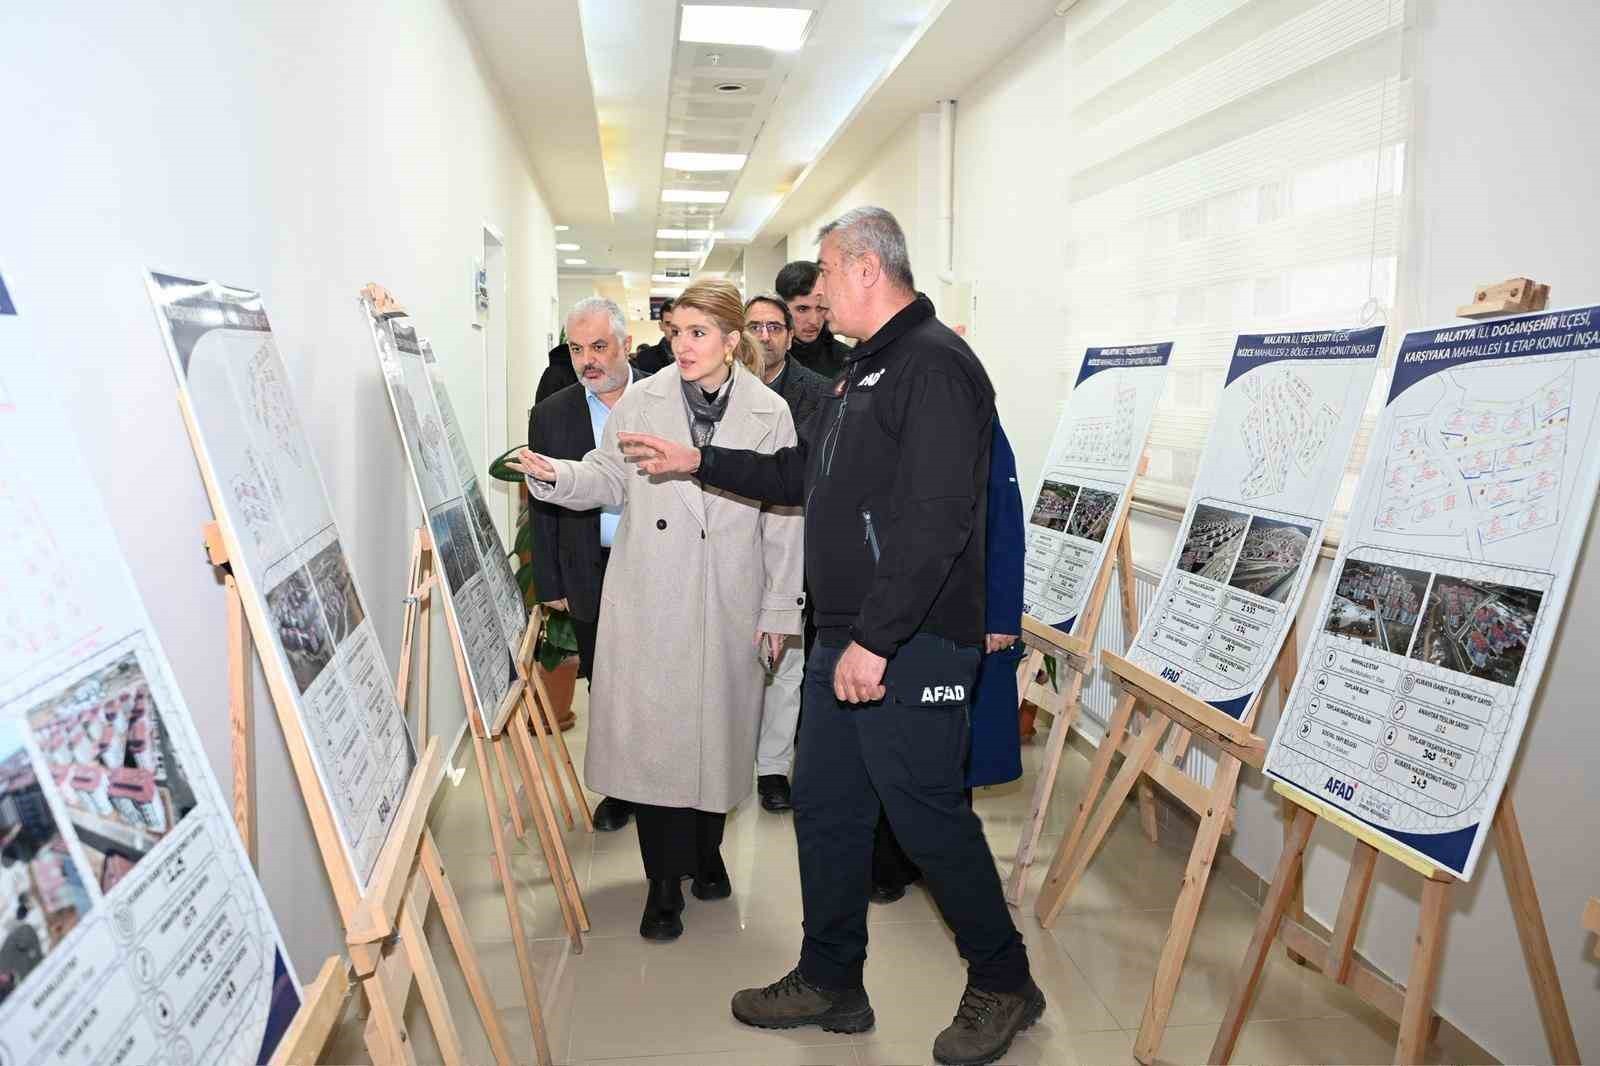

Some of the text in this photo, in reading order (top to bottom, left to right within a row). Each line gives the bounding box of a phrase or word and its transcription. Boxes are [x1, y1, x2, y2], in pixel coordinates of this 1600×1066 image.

[1434, 327, 1476, 344] MALATYA
[1491, 315, 1558, 337] DOĞANŞEHİR
[1558, 309, 1591, 330] İLÇESİ,
[1404, 347, 1451, 364] KARŞIYAKA
[1451, 340, 1502, 358] MAHALLESİ
[1511, 338, 1535, 353] ETAP
[1536, 333, 1574, 350] KONUT
[1572, 330, 1600, 349] İNŞA
[1160, 666, 1180, 683] AFAD
[920, 685, 965, 703] AFAD
[1324, 776, 1354, 801] AFAD
